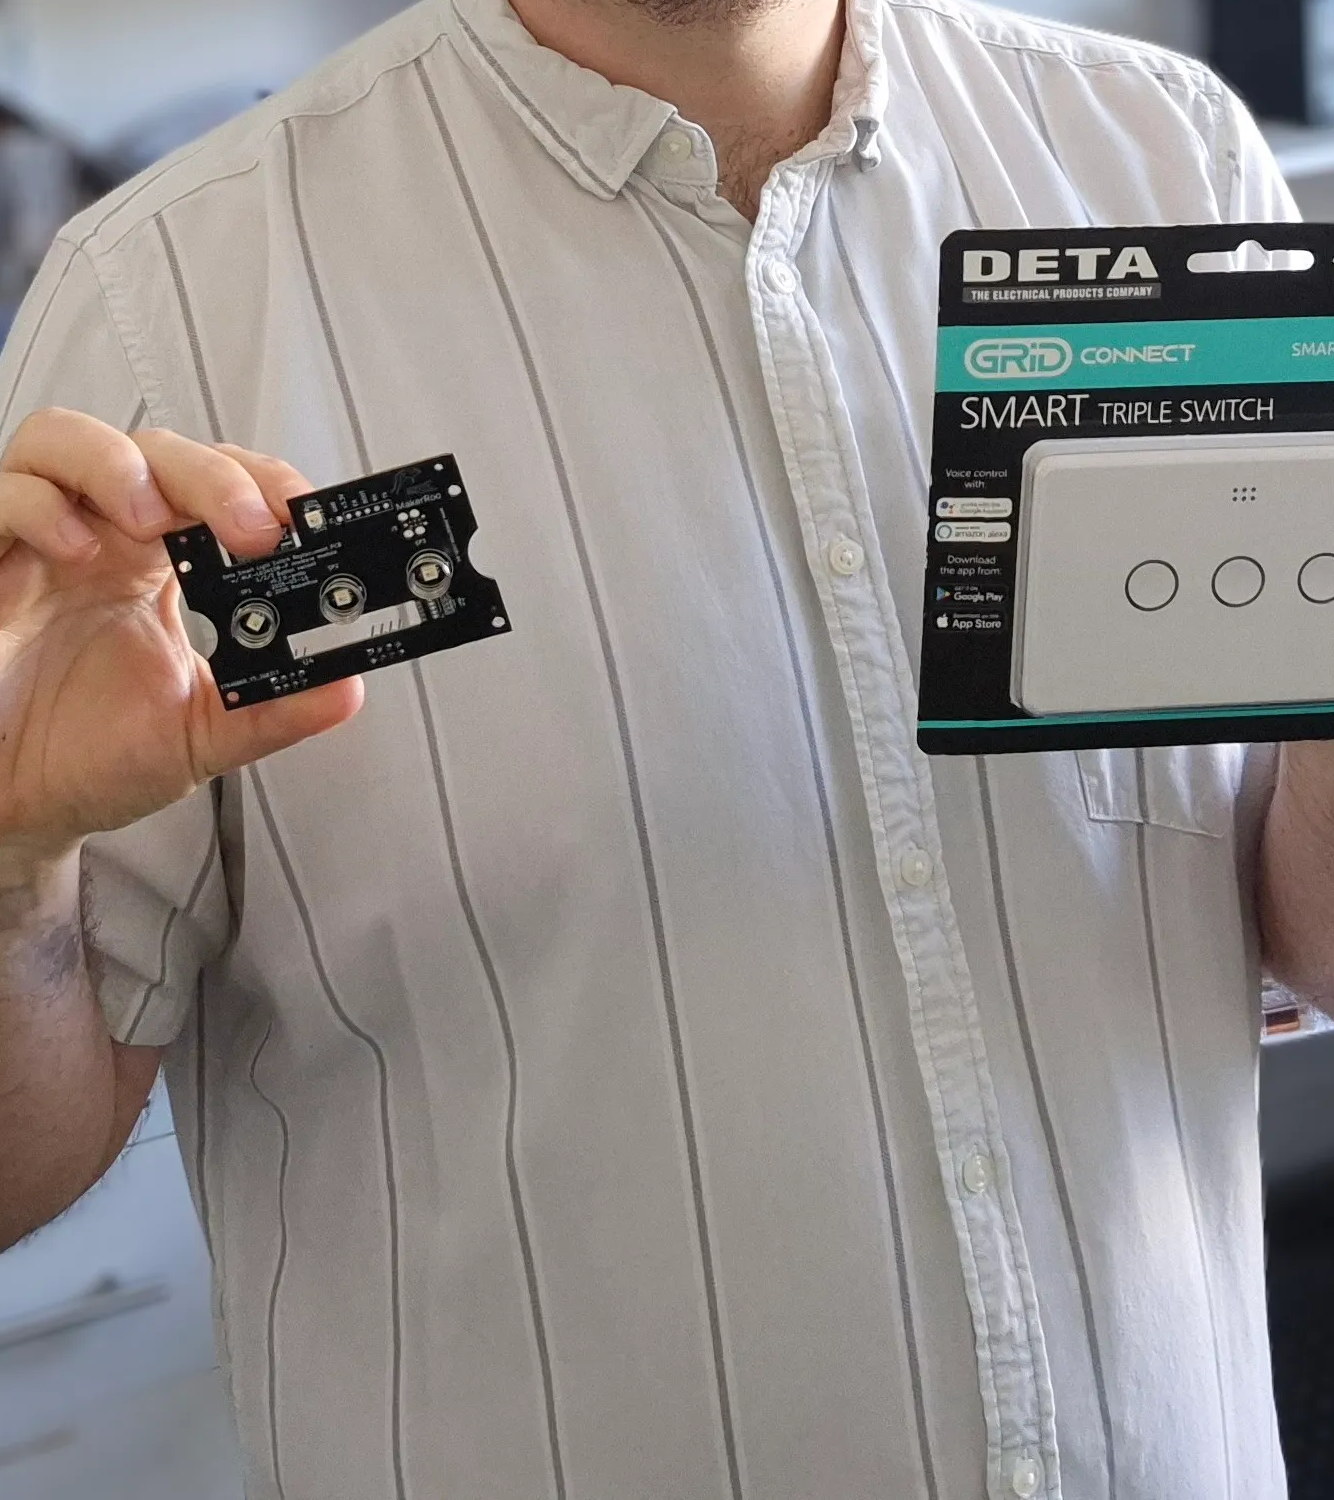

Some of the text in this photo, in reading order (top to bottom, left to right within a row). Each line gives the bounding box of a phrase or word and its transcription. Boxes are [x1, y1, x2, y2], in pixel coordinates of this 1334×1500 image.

[963, 246, 1159, 282] DETA
[971, 286, 1153, 301] THE ELECTRICAL PRODUCTS COMPANY
[1080, 344, 1196, 365] CONNECT
[960, 393, 1274, 430] SMART TRIPLE SWITCH
[945, 468, 1008, 478] Voice control
[964, 480, 985, 488] with
[947, 555, 996, 564] Download
[940, 567, 955, 575] the
[957, 567, 976, 576] app
[953, 592, 1004, 603] Google Play
[952, 619, 1002, 630] App Store
